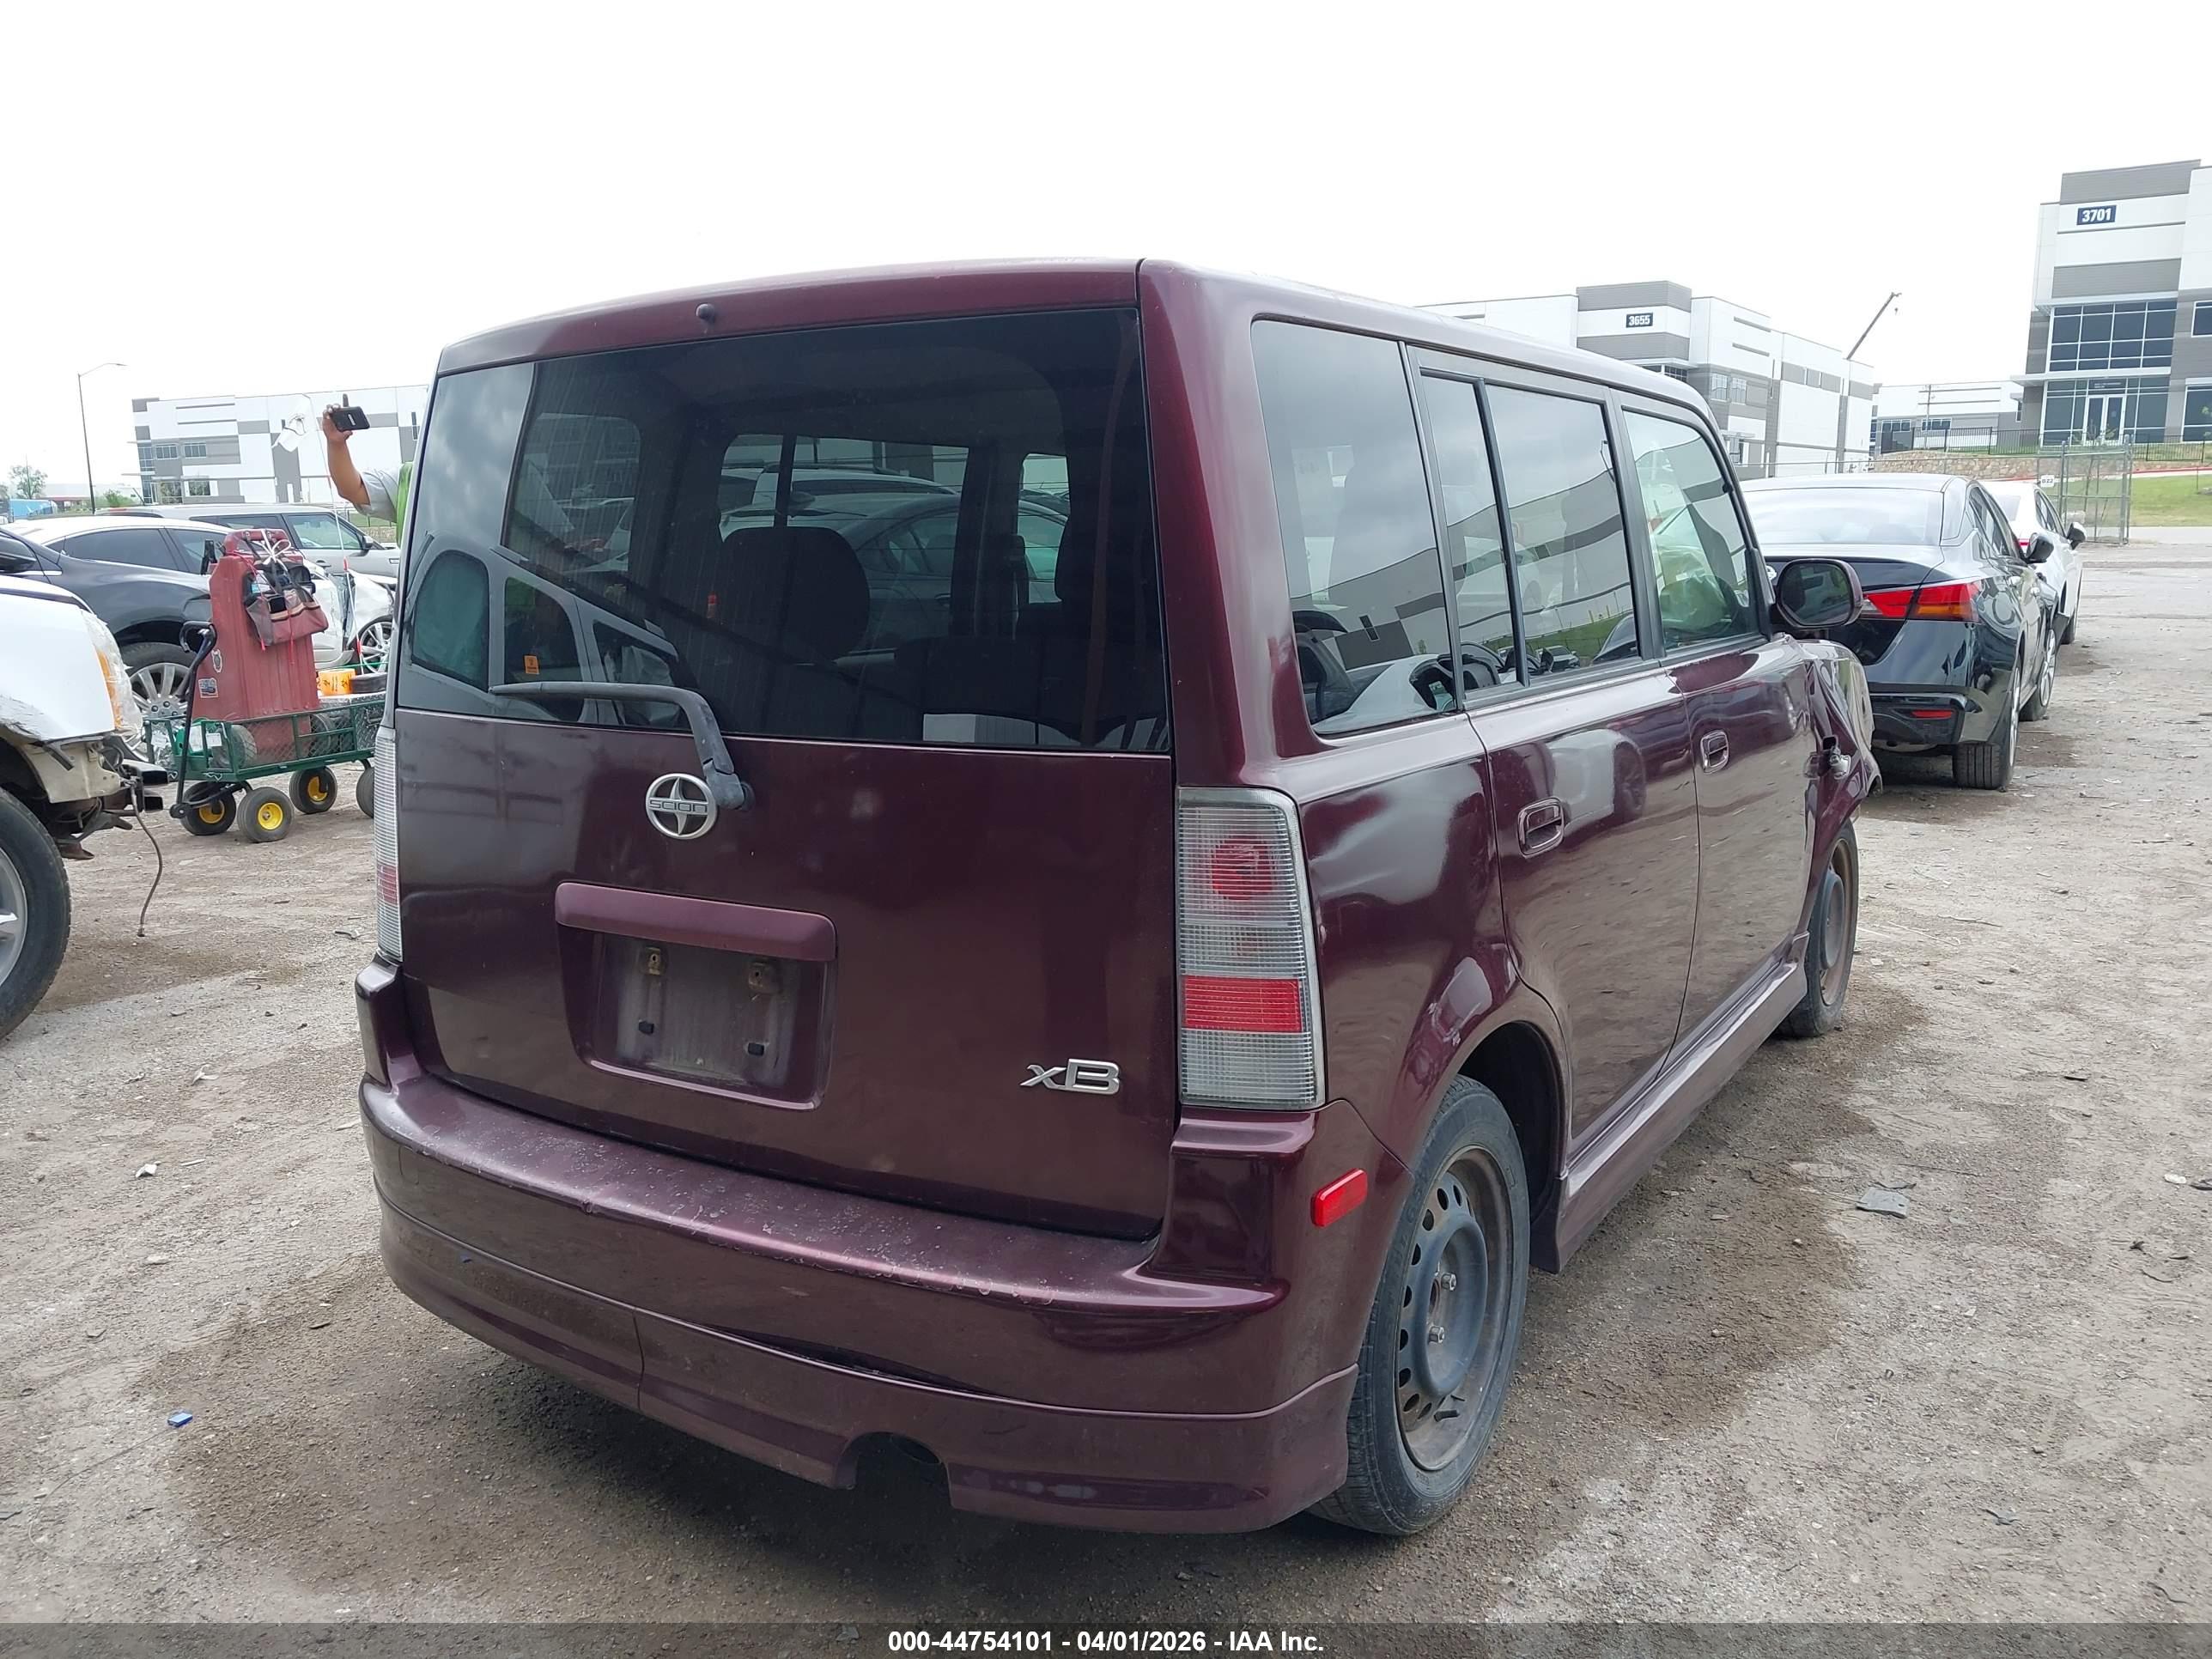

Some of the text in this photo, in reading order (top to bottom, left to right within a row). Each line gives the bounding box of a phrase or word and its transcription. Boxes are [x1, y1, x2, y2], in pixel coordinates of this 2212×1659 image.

[2081, 208, 2112, 222] 3701
[1628, 314, 1650, 326] 3655
[649, 799, 708, 813] SCION
[1020, 1058, 1120, 1095] xB
